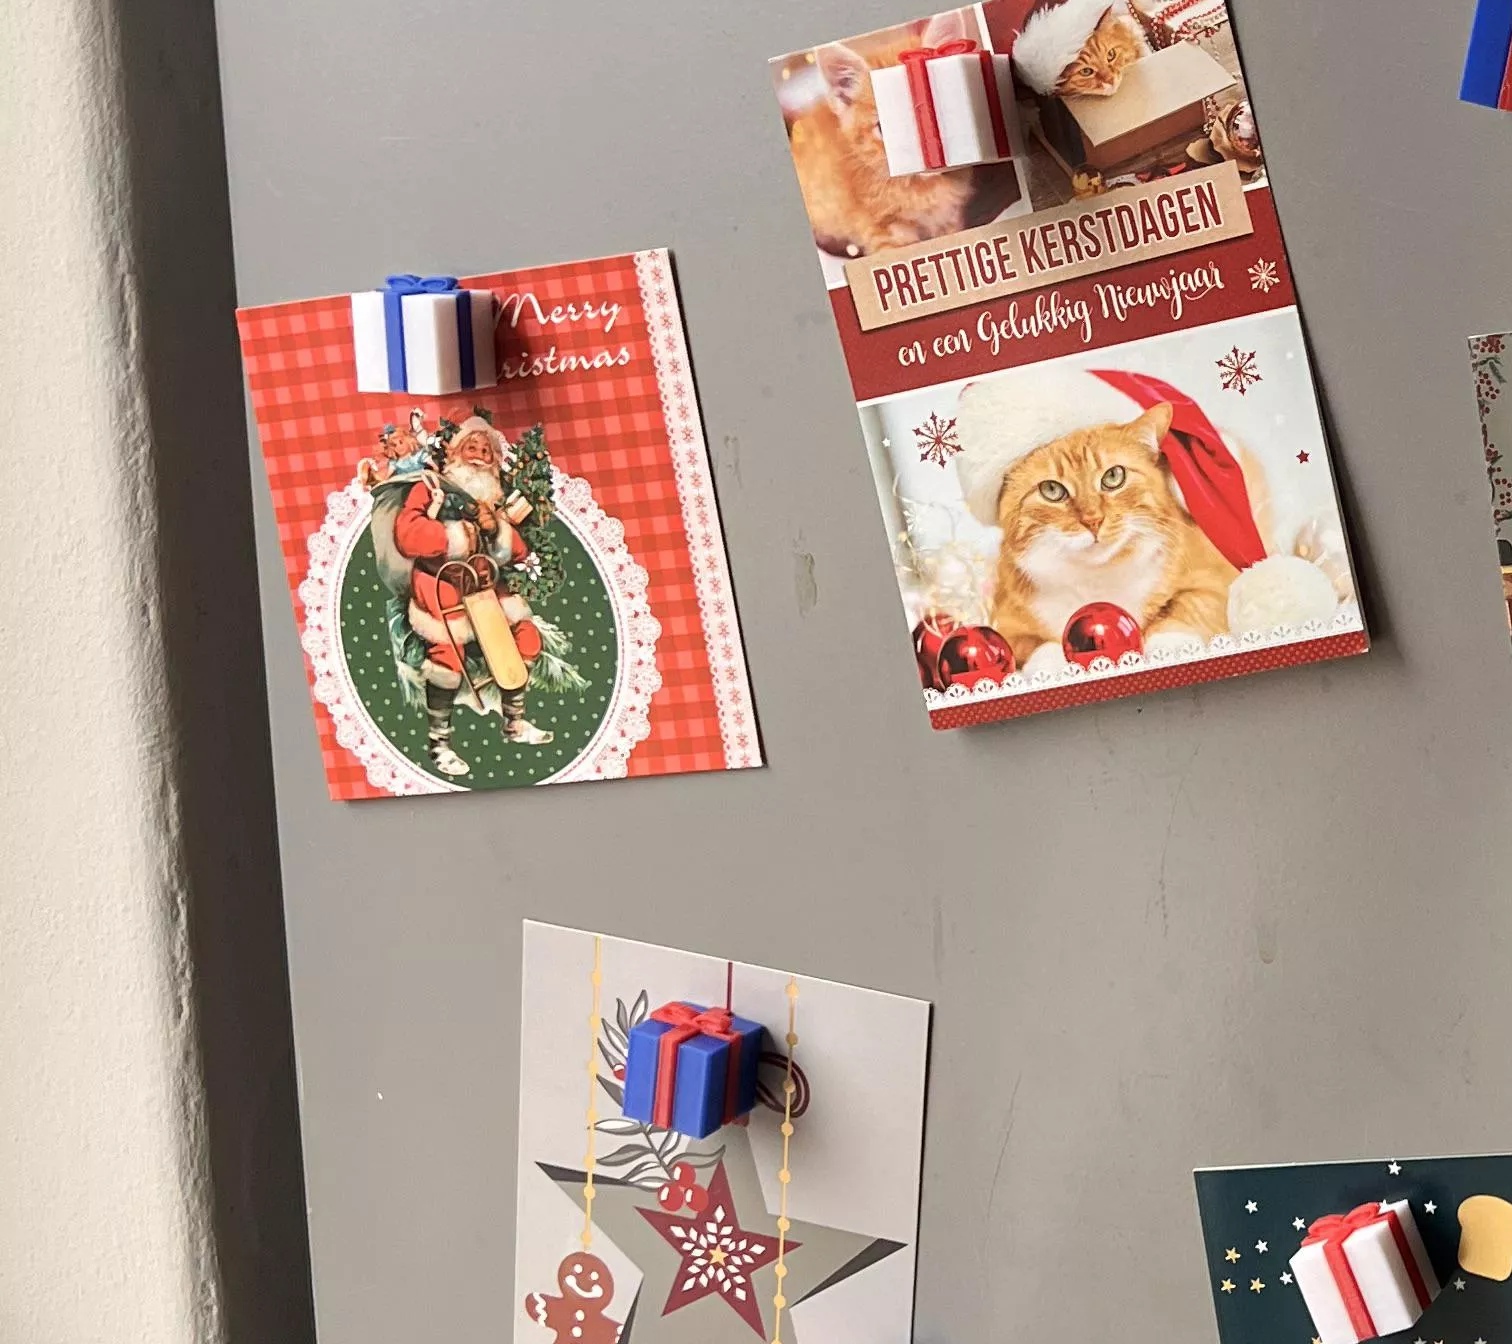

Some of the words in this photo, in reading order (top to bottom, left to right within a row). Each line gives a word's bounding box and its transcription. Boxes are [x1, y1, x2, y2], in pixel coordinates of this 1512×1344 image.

[873, 236, 1016, 312] PRETTIGE
[1019, 182, 1223, 275] KERSTDAGEN
[496, 293, 621, 333] Merry
[898, 335, 927, 366] en
[932, 328, 973, 358] een
[977, 298, 1092, 356] Gelukkig
[1094, 262, 1224, 321] Nieuwjaar
[497, 346, 630, 379] ristmas
